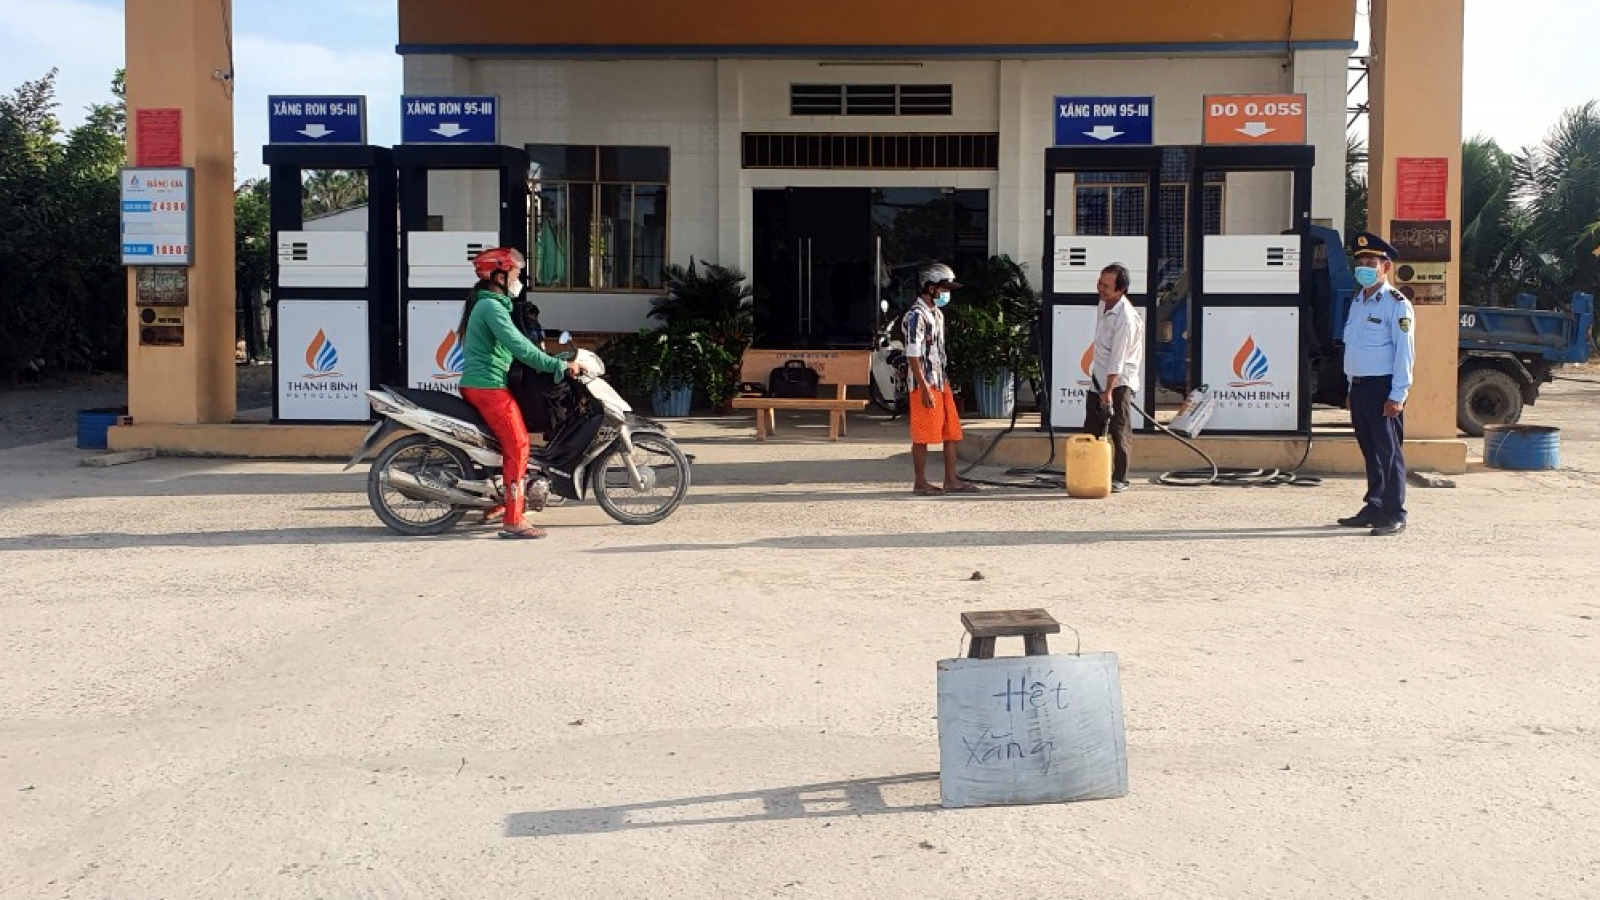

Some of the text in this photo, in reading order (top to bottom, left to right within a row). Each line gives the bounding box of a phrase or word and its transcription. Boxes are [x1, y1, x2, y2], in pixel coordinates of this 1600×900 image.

[273, 101, 357, 116] XĂNG RON 95-III
[406, 100, 493, 115] XĂNG RON 95-III
[1060, 102, 1149, 118] XĂNG RON 95-III
[1210, 102, 1303, 117] DO 0.05S
[1460, 313, 1476, 327] 40
[287, 381, 358, 391] THANH BINH
[416, 381, 458, 391] THANH
[1060, 388, 1085, 398] THA
[1213, 391, 1290, 401] THANH BINH
[993, 670, 1069, 712] Hết
[962, 727, 1054, 774] Xăng
